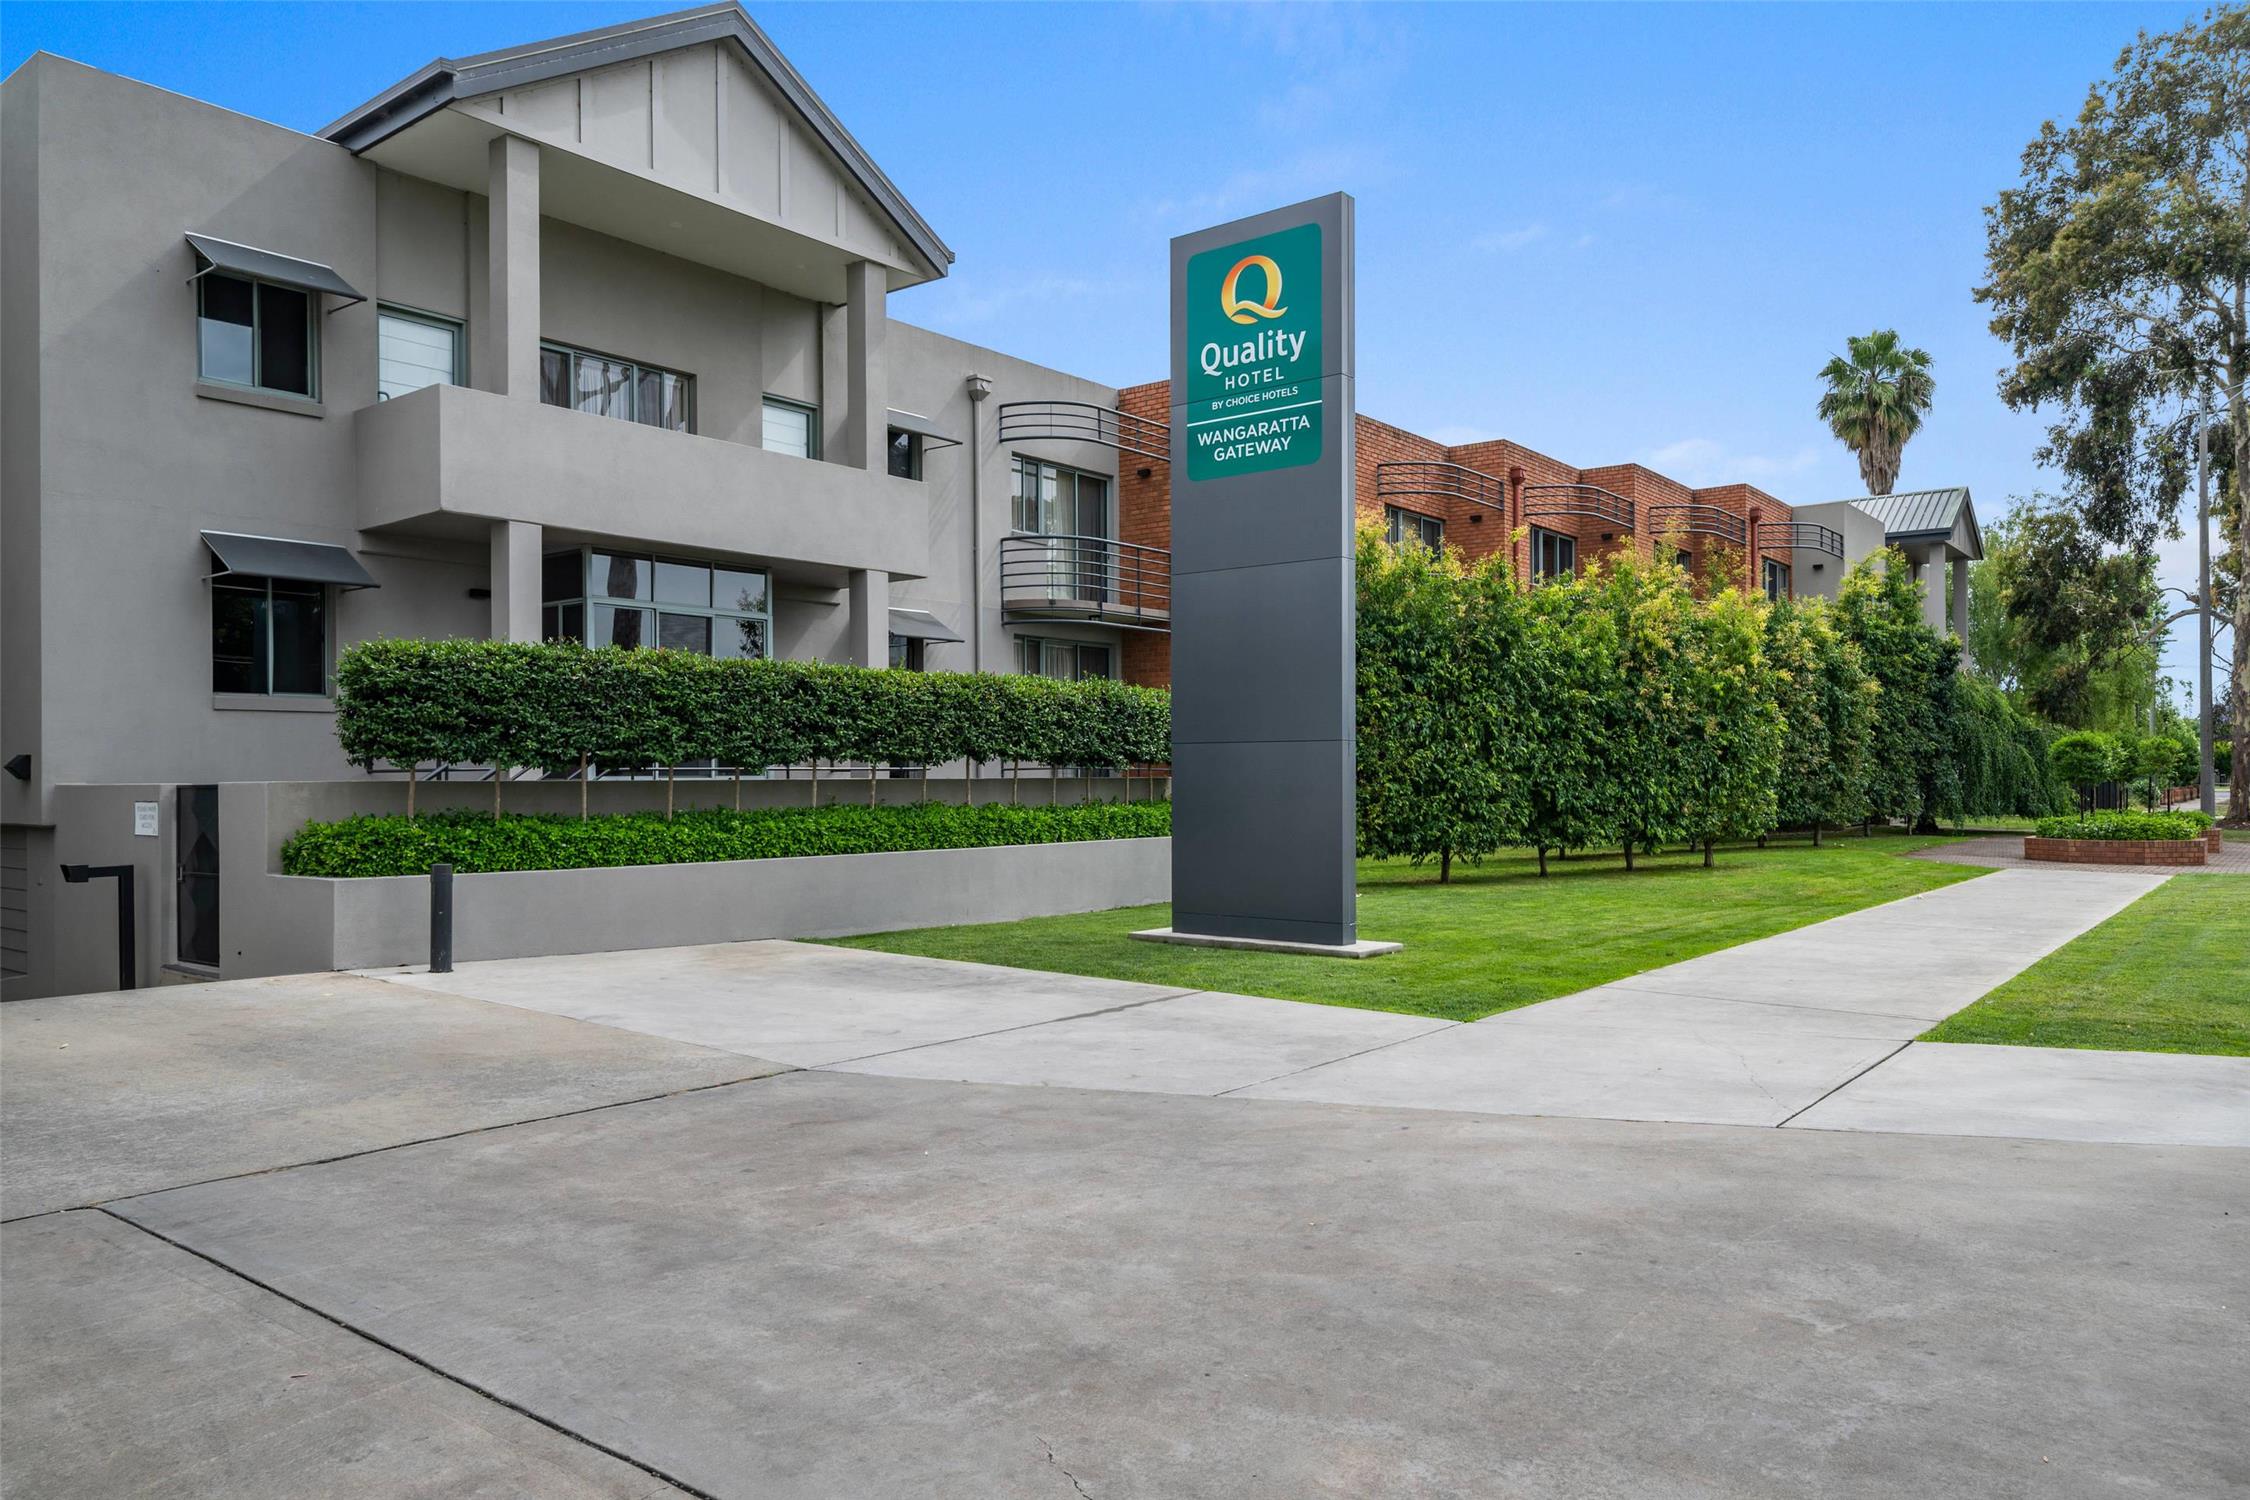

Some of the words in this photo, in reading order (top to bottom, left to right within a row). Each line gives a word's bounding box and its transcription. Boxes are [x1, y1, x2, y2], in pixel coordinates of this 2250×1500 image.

[1221, 255, 1288, 325] Q
[1200, 329, 1307, 377] Quality
[1224, 367, 1285, 391] HOTEL
[1211, 400, 1224, 411] BY
[1225, 393, 1260, 408] CHOICE
[1262, 386, 1299, 401] HOTELS
[1197, 414, 1311, 447] WANGARATTA
[1213, 436, 1292, 462] GATEWAY
